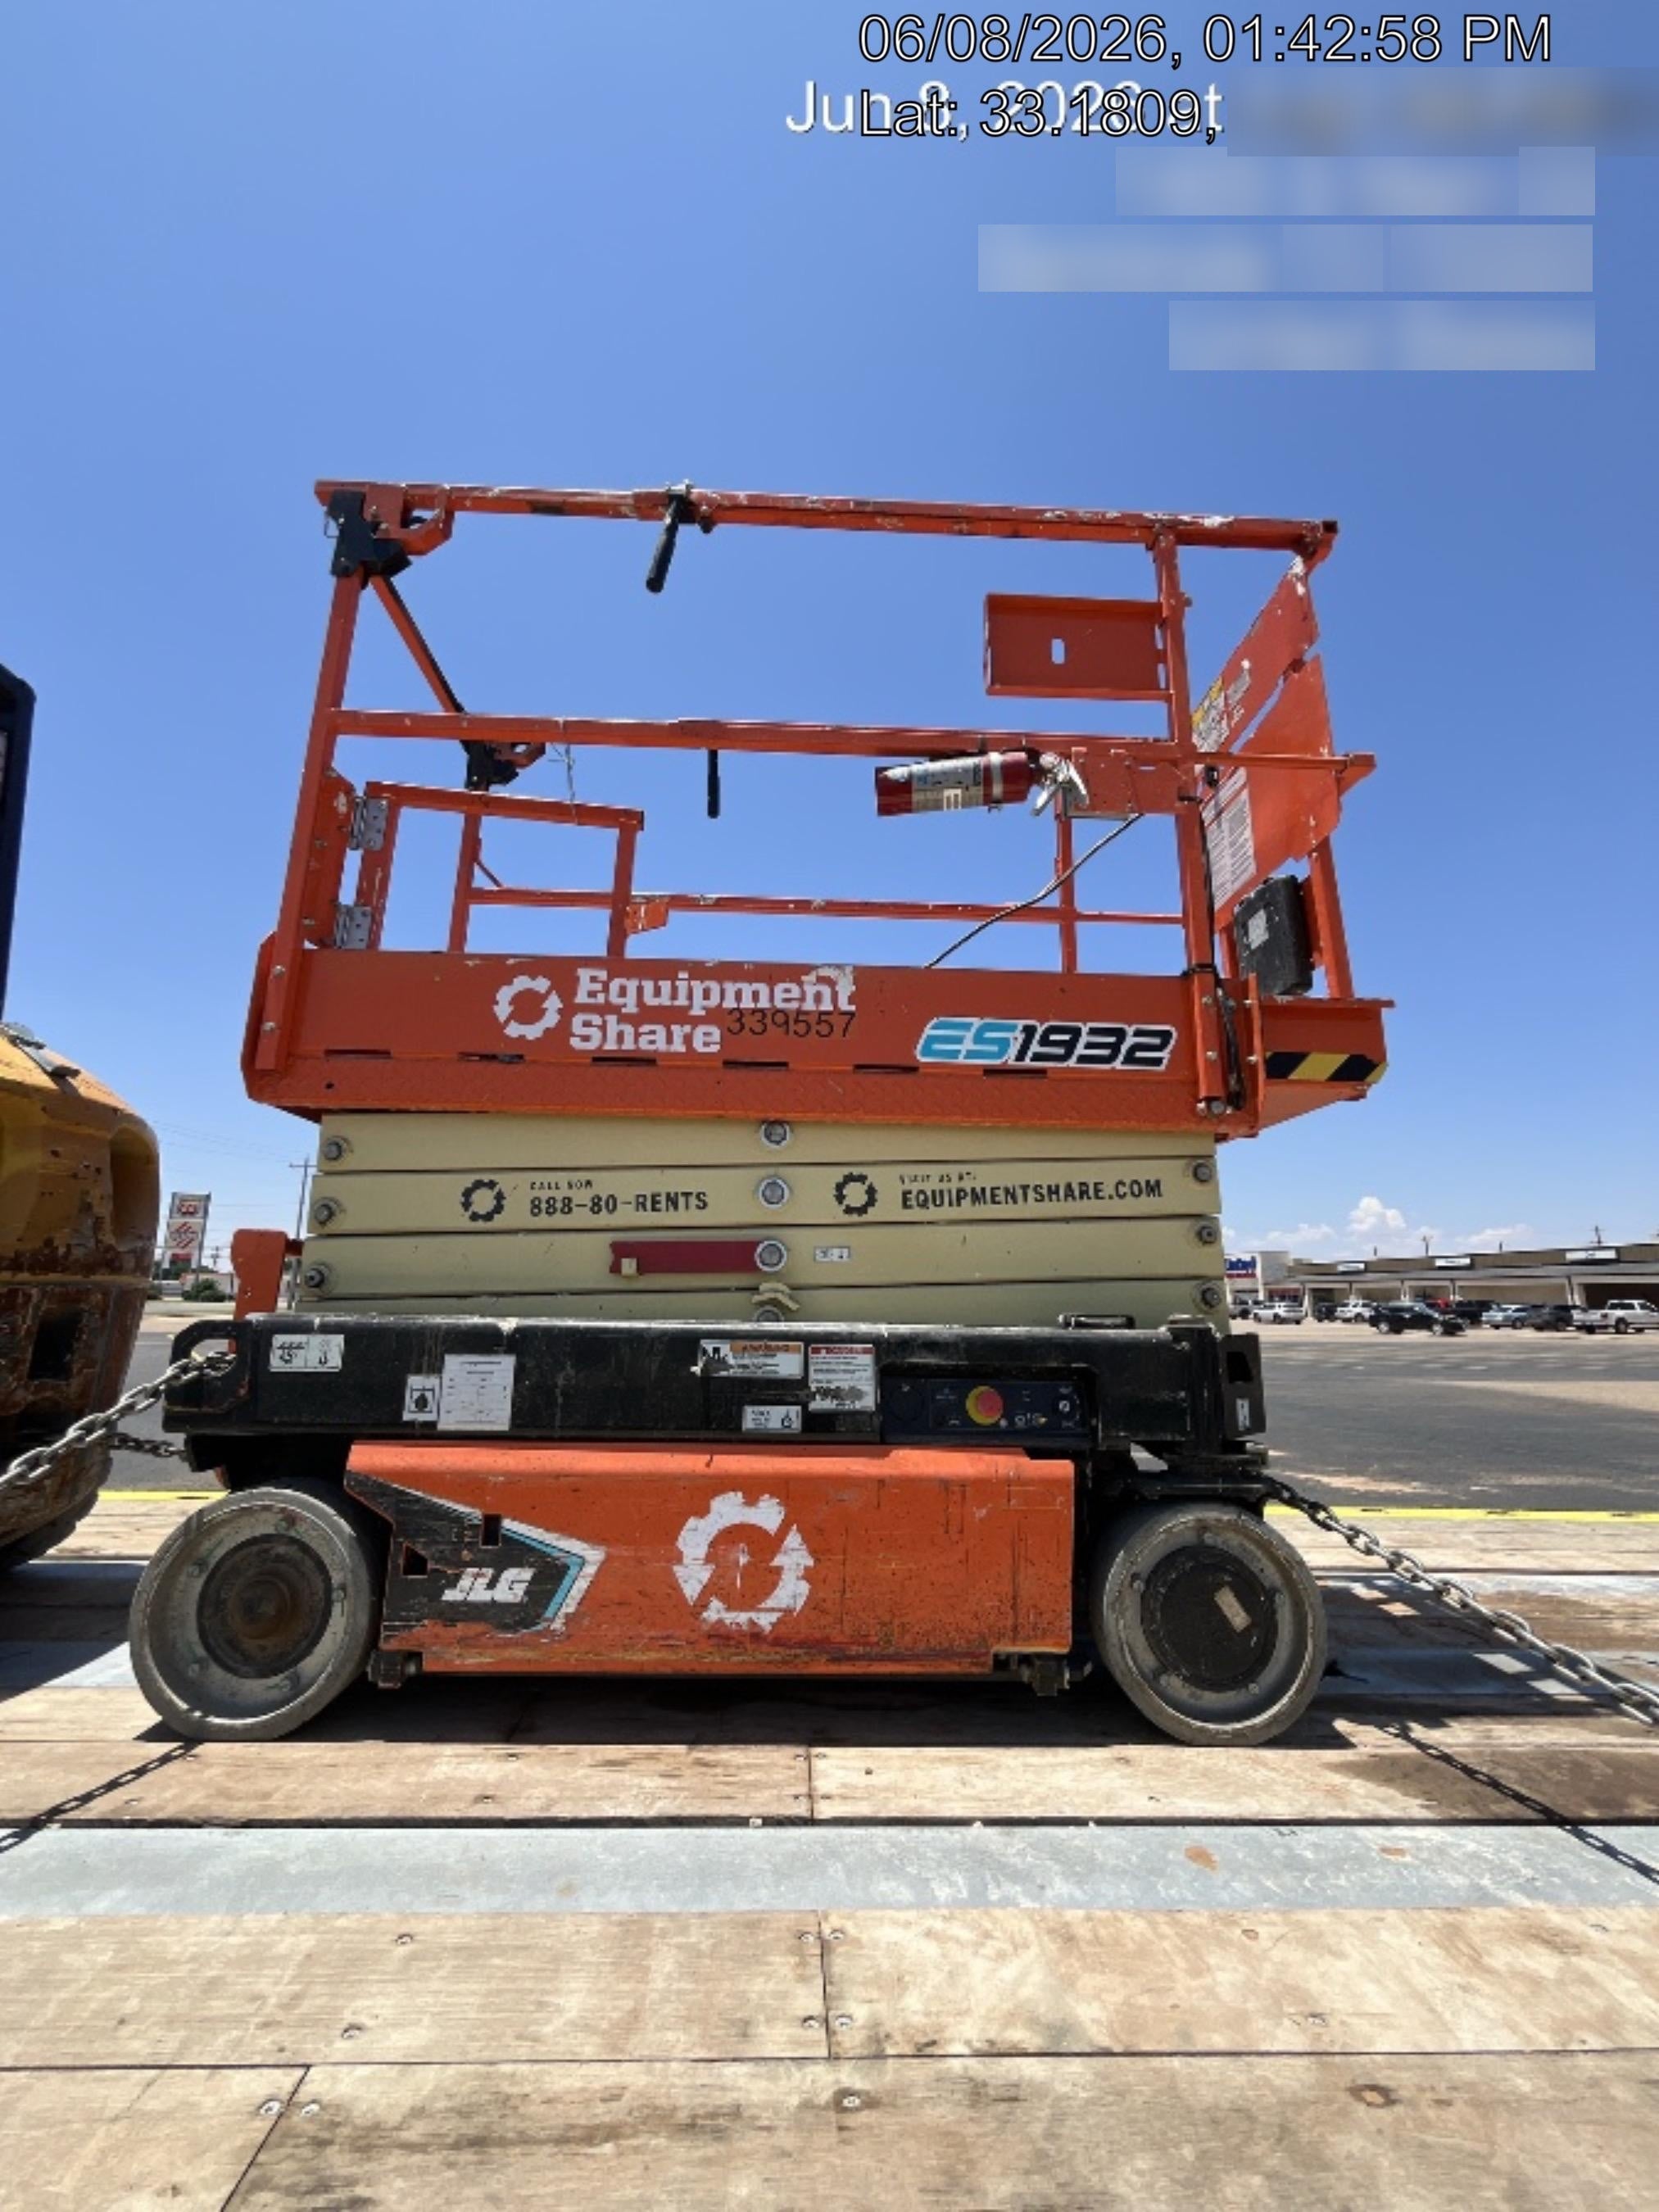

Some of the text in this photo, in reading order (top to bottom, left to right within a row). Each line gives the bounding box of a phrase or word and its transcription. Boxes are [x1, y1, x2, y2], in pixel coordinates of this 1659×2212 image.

[573, 964, 857, 1017] Equipment
[569, 1012, 722, 1054] Share
[726, 1007, 857, 1039] 339557
[916, 1017, 1177, 1070] ES1932
[529, 1191, 709, 1217] 888-80-RENTS
[900, 1178, 1164, 1211] EQUIPMENTSHARE.COM
[441, 1566, 537, 1604] JLG
